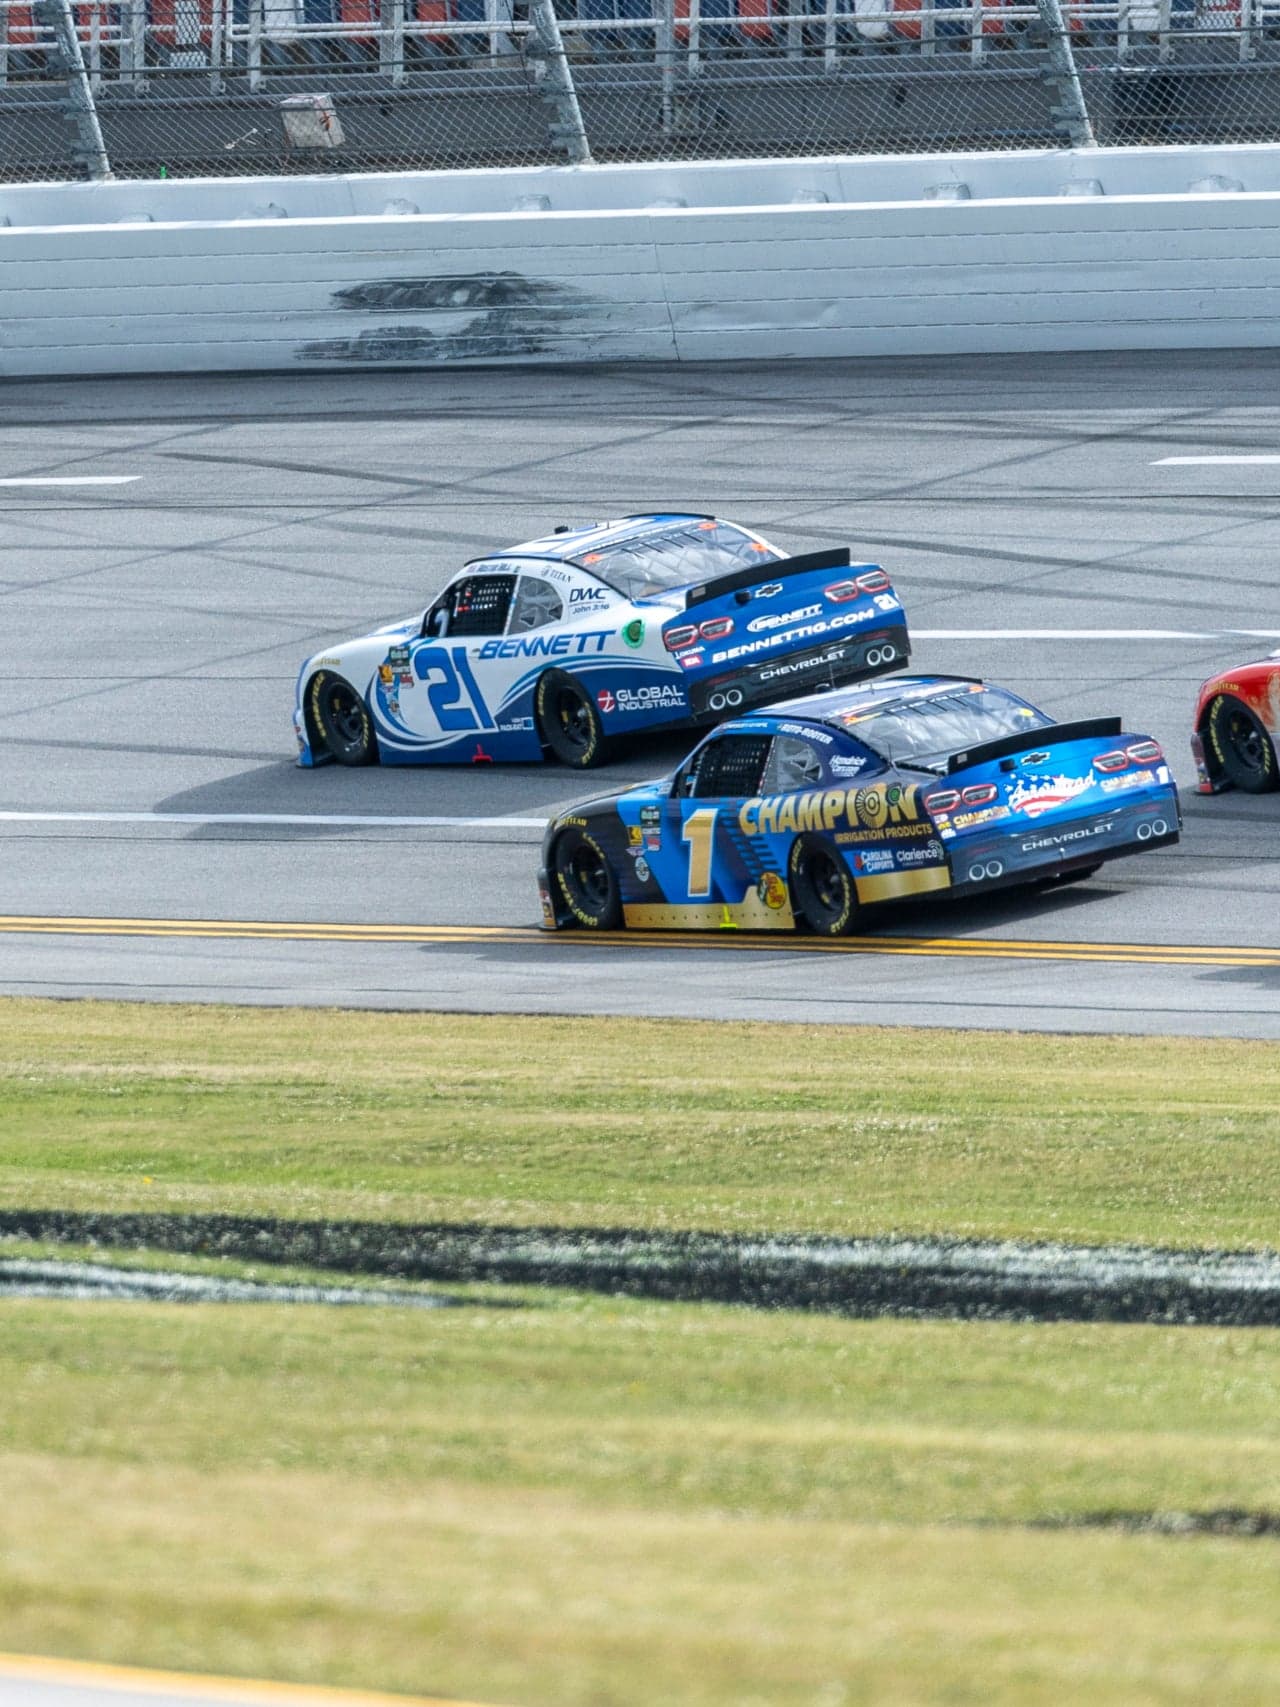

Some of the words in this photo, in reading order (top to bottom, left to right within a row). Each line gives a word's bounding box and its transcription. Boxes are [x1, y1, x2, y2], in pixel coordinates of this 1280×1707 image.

[570, 588, 611, 603] DWC
[874, 594, 900, 610] 21
[755, 603, 824, 630] BENNETT
[478, 630, 617, 660] BENNETT
[712, 608, 876, 663] BENNETTIG.COM
[760, 654, 848, 681] CHEVROLET
[414, 645, 499, 731] 21
[616, 685, 684, 702] GLOBAL
[618, 697, 686, 712] INDUSTRIAL
[1156, 765, 1173, 786] 1
[740, 782, 919, 835] CHAMPION
[834, 828, 884, 845] IRRIGATION
[885, 823, 934, 842] PRODUCTS
[1022, 823, 1117, 852] CHEVROLET
[681, 808, 720, 898] 1
[860, 849, 894, 863] CAROLINA
[895, 846, 938, 863] Clarience
[866, 858, 896, 873] CARPORTS
